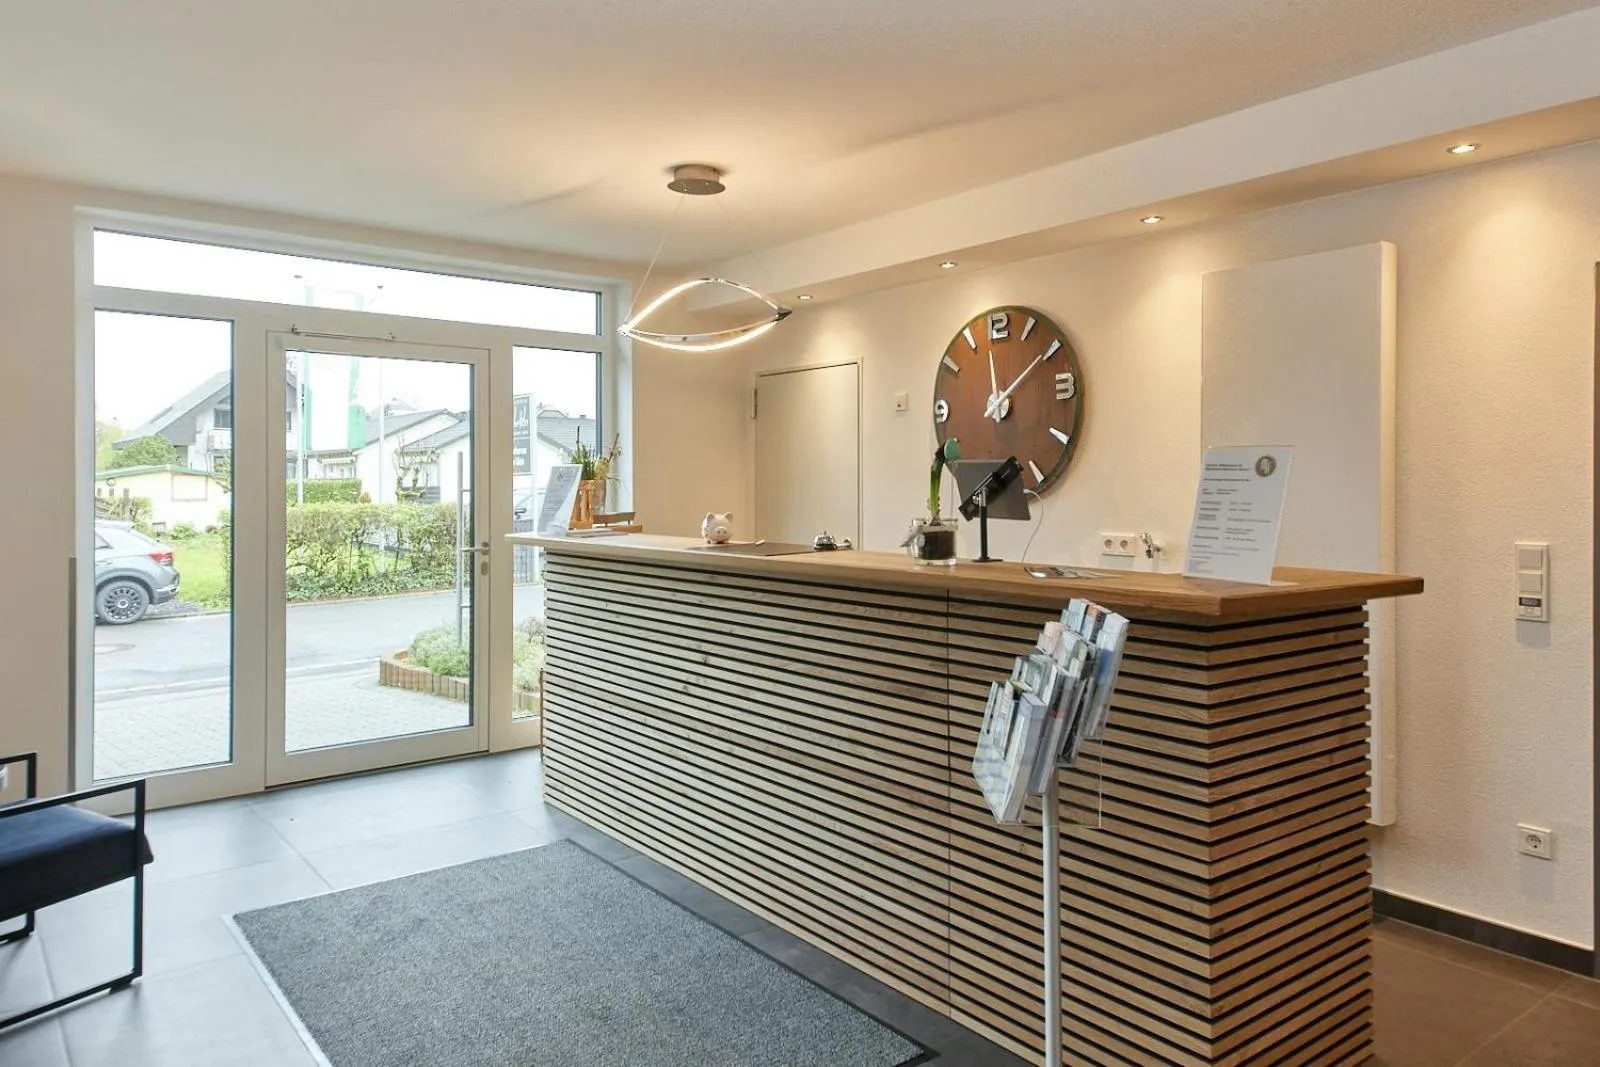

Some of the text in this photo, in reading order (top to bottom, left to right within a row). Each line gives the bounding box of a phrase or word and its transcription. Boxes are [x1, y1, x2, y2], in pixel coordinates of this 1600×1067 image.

[988, 313, 1010, 340] 12
[1055, 373, 1075, 400] 3
[934, 399, 949, 423] 9
